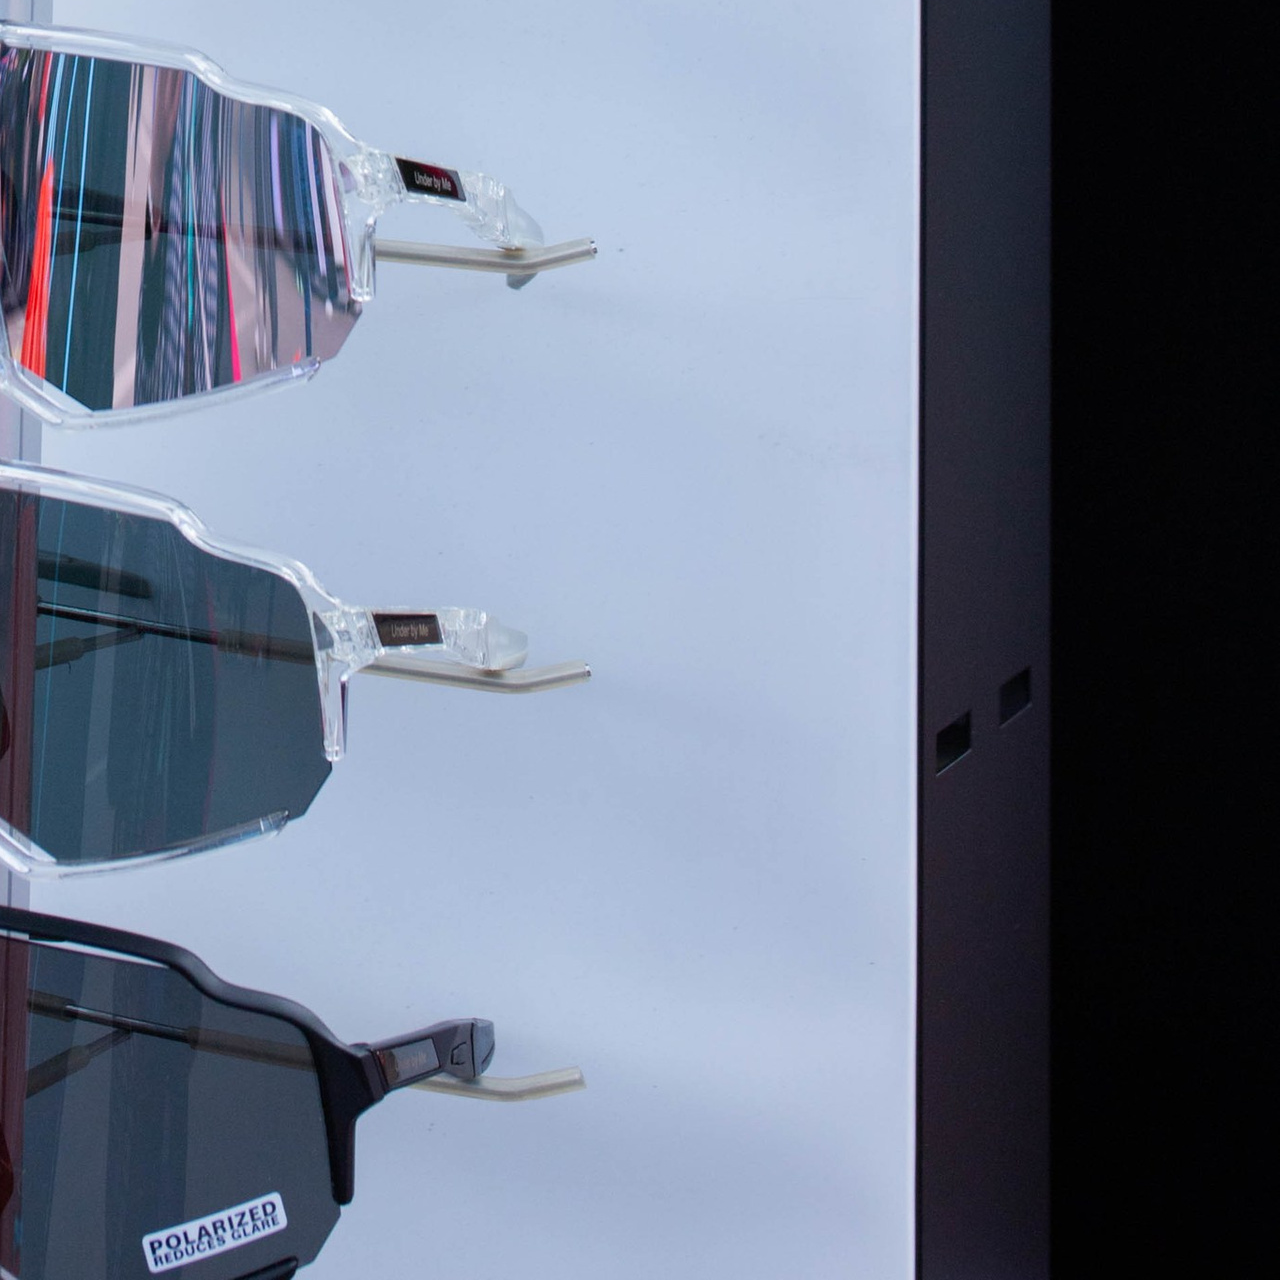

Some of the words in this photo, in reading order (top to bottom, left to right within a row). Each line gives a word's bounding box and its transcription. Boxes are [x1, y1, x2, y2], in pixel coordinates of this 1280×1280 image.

[413, 169, 433, 188] Under
[441, 176, 452, 192] Me
[390, 621, 411, 639] Under
[418, 622, 430, 638] Me
[149, 1200, 277, 1256] POLARIZED
[153, 1235, 227, 1268] REDUCES
[231, 1214, 280, 1240] GLARE
